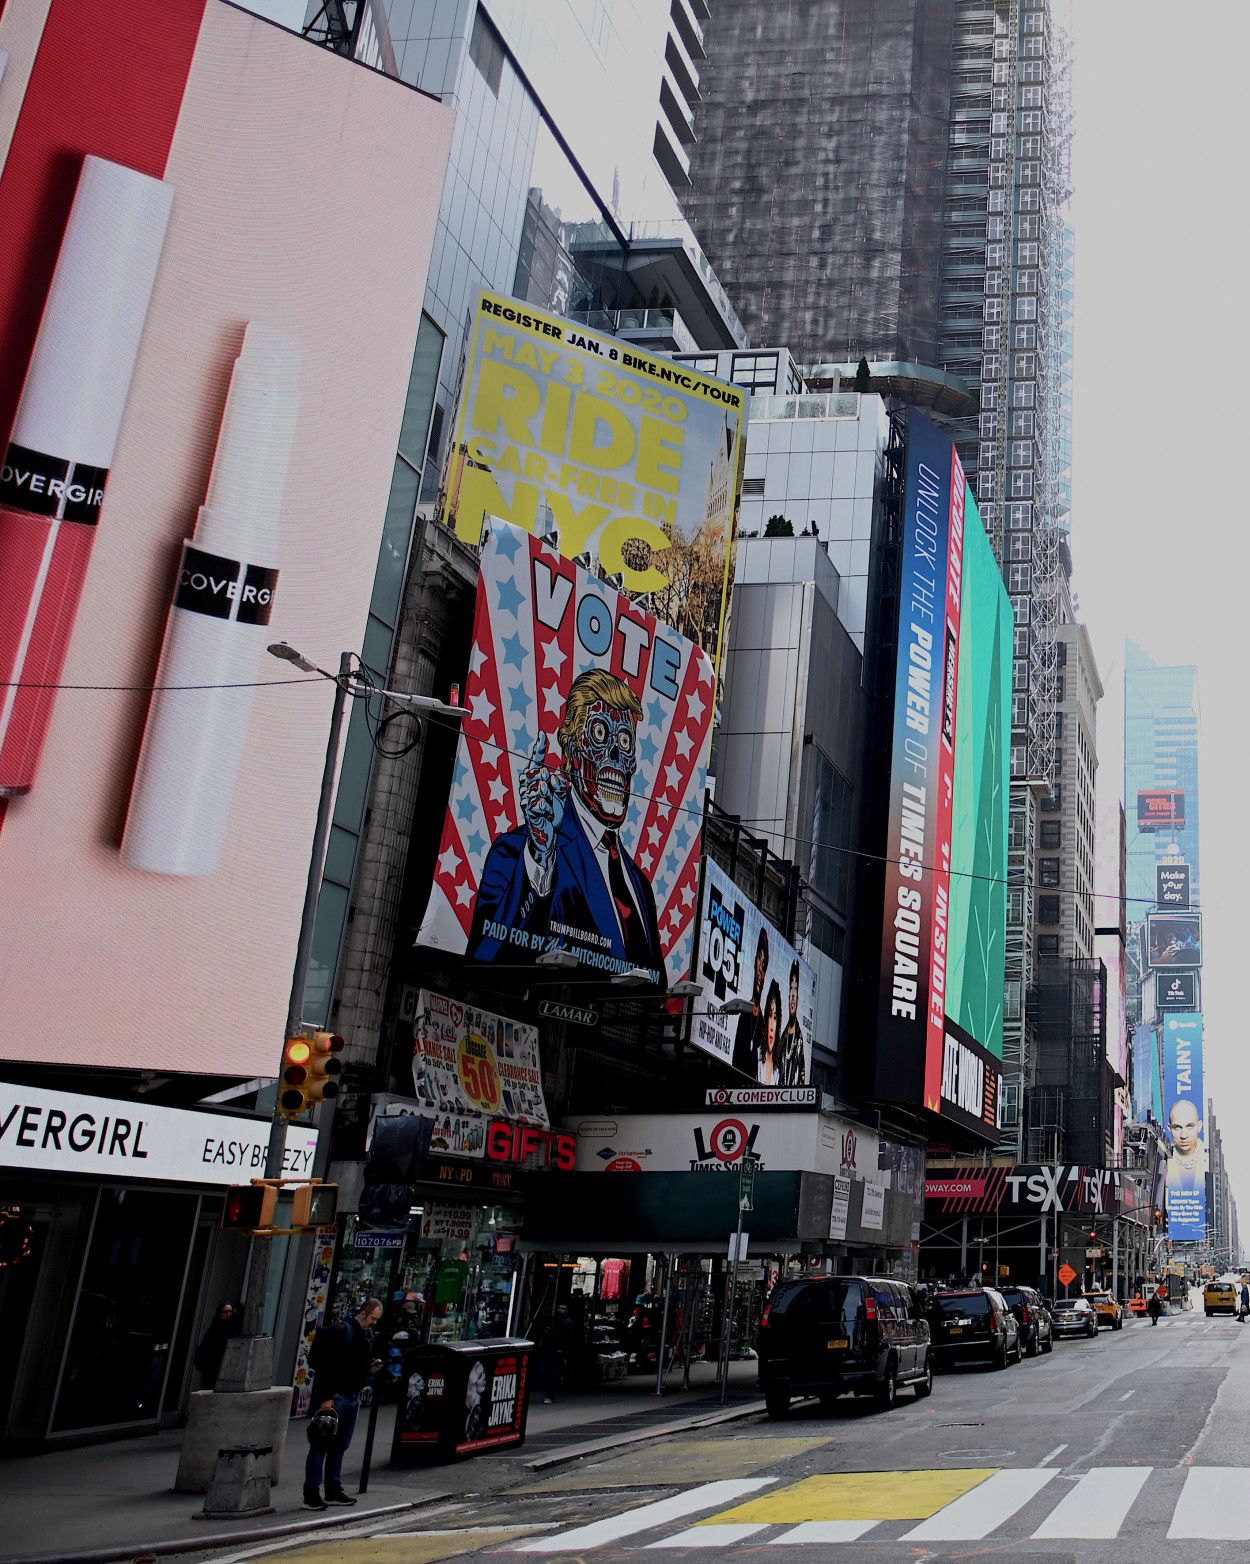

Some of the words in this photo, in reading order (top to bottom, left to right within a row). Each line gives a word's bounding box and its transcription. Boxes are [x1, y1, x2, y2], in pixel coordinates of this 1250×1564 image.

[481, 298, 562, 341] REGISTER
[567, 332, 604, 356] JAN.
[608, 348, 619, 361] 8
[622, 354, 740, 408] BIKE.NYC/TOUR
[483, 328, 559, 374] MAY
[562, 361, 592, 393] 3,
[598, 371, 689, 423] 2020
[471, 358, 687, 494] RIDE
[467, 436, 638, 509] CAR-FREE
[642, 490, 679, 525] IN
[455, 463, 674, 593] NYC
[914, 462, 940, 571] UNLOCK
[910, 570, 937, 624] THE
[532, 557, 681, 702] VOTE
[906, 622, 933, 737] POWER
[904, 736, 928, 778] OF
[899, 781, 926, 883] TIMES
[1160, 870, 1186, 880] Make
[1162, 880, 1184, 892] your
[1163, 890, 1183, 901] day.
[482, 918, 508, 942] PAID
[508, 927, 529, 948] FOR
[530, 932, 545, 951] BY
[549, 919, 613, 950] TRUMPBILLBOARD.COM
[710, 898, 742, 944] POWER
[702, 917, 745, 993] 105.1
[890, 885, 922, 1022] SQUARE
[542, 1001, 593, 1024] LAMAR
[1176, 1037, 1193, 1096] TAINY
[202, 1138, 249, 1167] EASY
[250, 1144, 313, 1174] BREZY
[487, 1120, 577, 1172] GIFTS
[438, 1165, 453, 1180] NY
[1005, 1165, 1065, 1212] TSX
[1083, 1168, 1104, 1213] TSX
[426, 1387, 444, 1396] JAYNE
[427, 1378, 445, 1388] ERIKA
[490, 1374, 517, 1402] ERIKA
[488, 1400, 515, 1427] JAYNE
